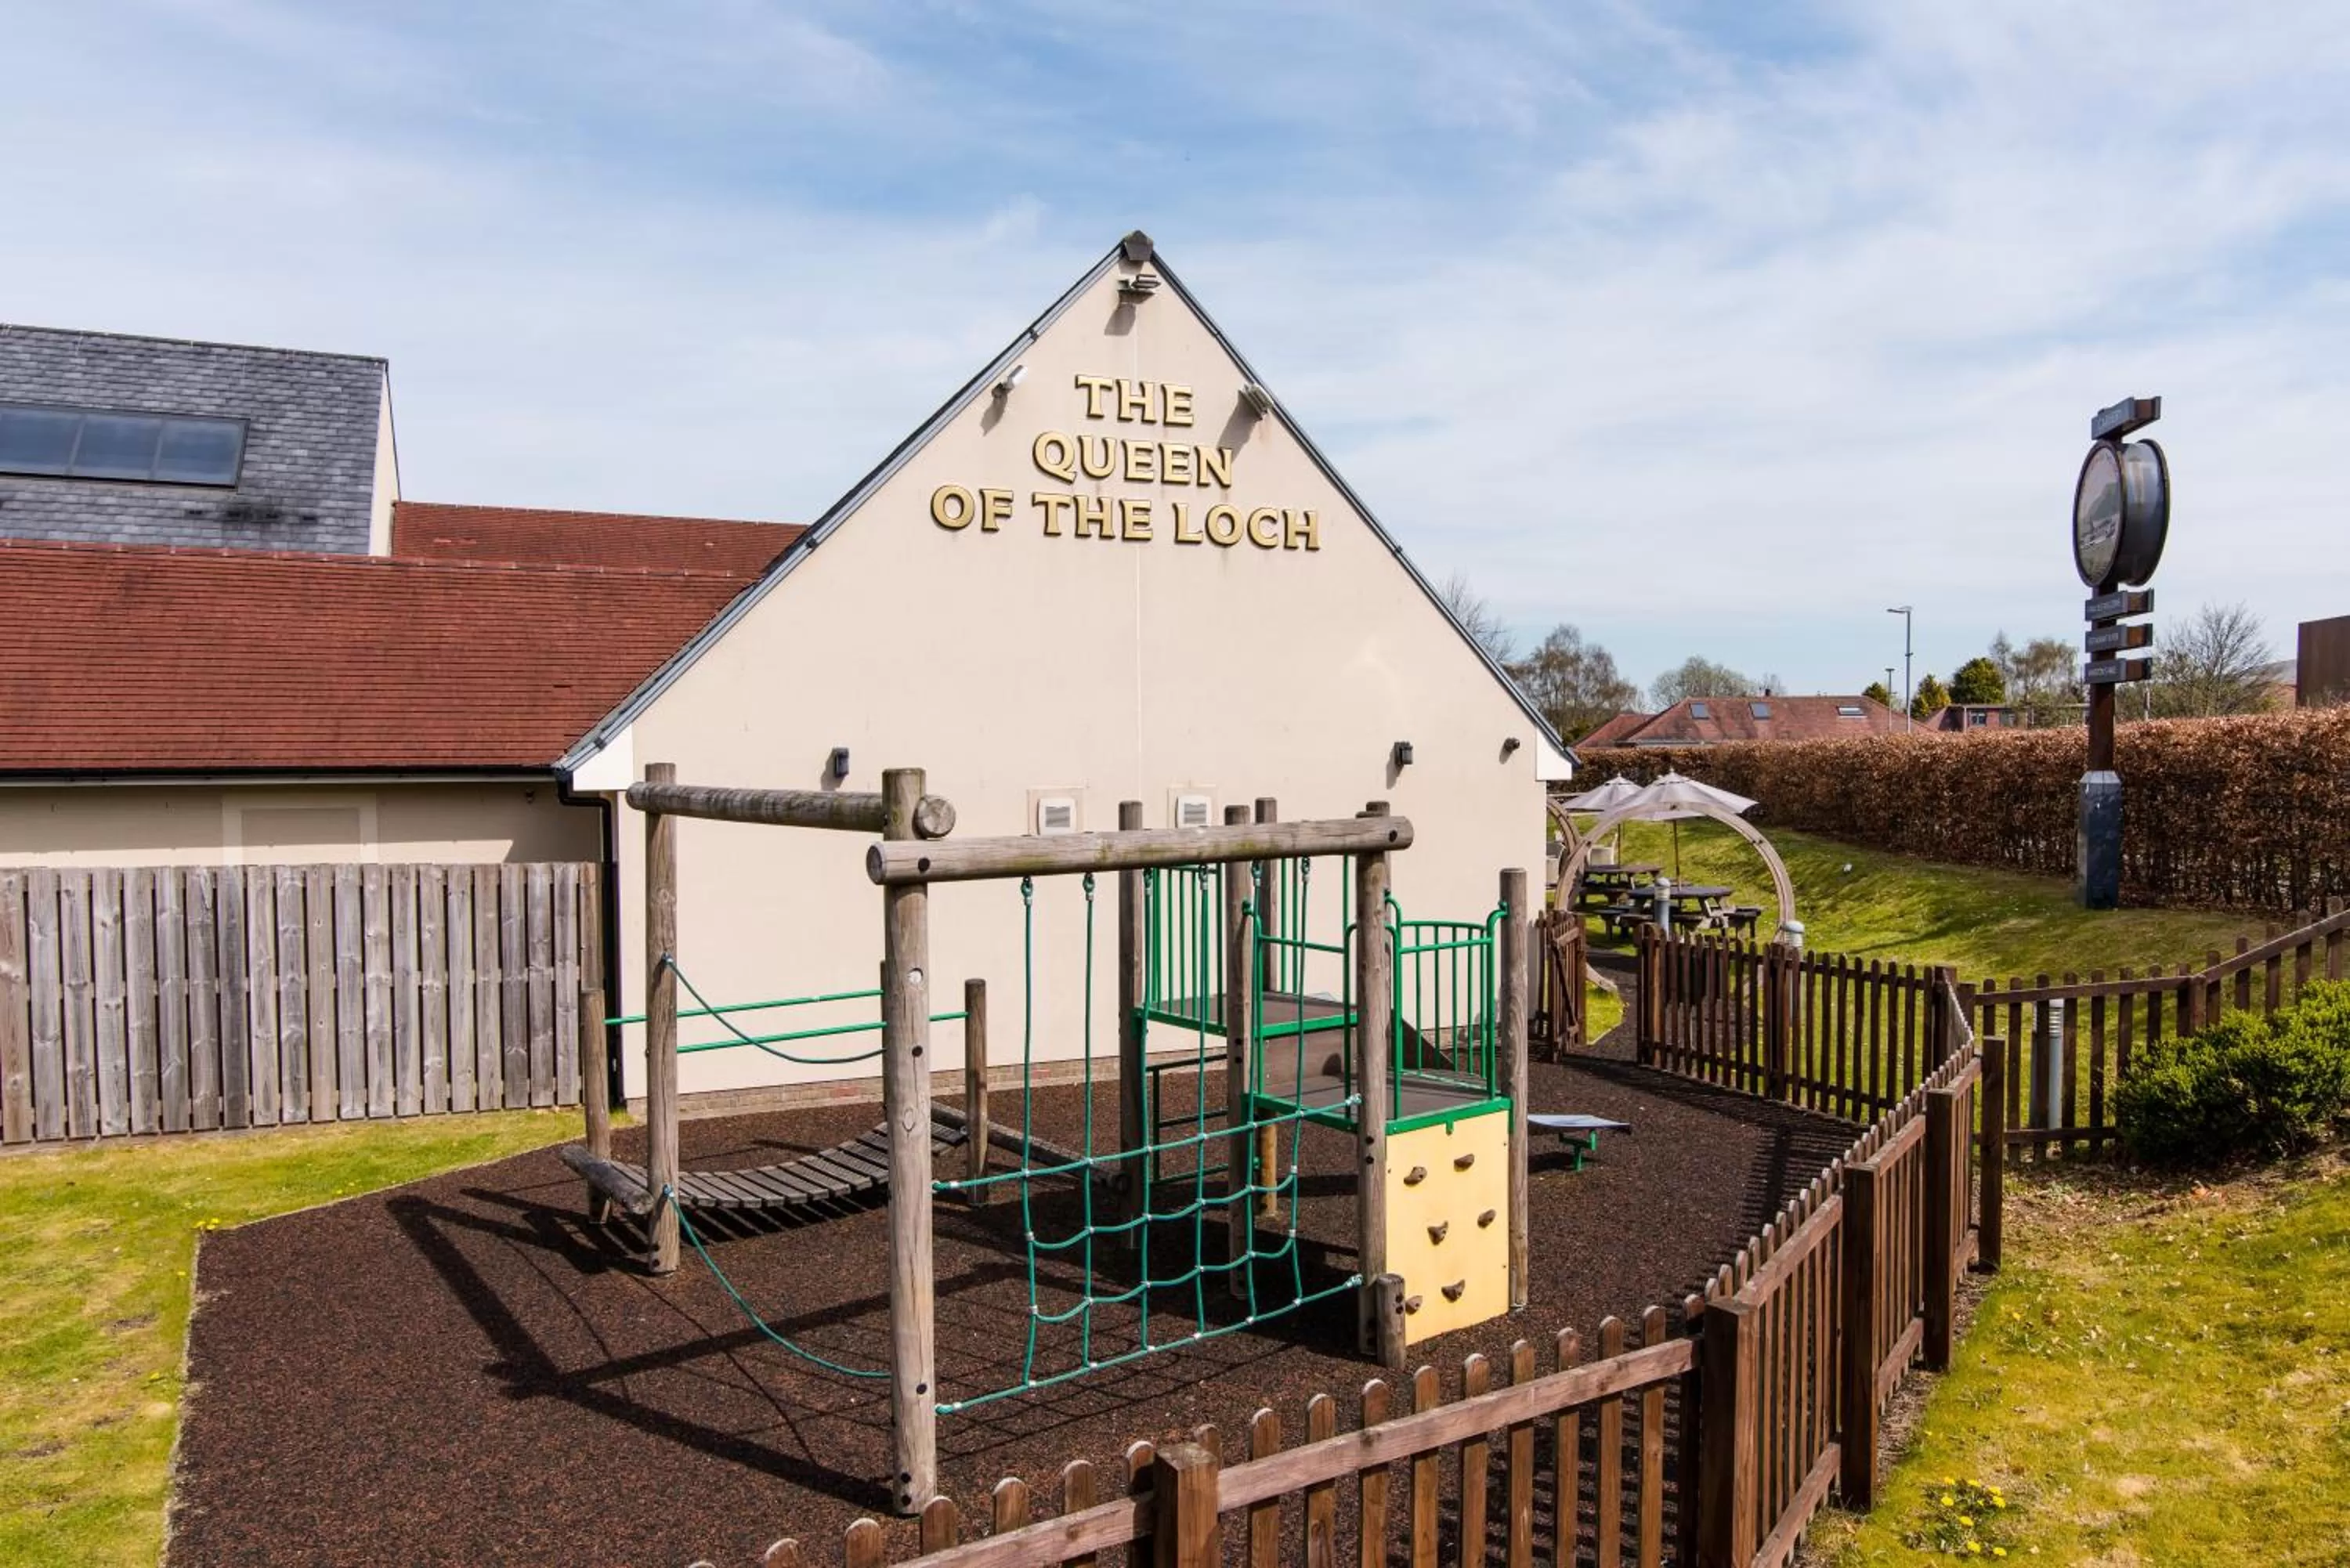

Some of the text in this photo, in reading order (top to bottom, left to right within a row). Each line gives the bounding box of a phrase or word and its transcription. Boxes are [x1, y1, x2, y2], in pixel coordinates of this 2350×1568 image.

[1076, 375, 1194, 426] THE
[1033, 432, 1232, 487] QUEEN
[931, 484, 1321, 550] OF THE LOCH
